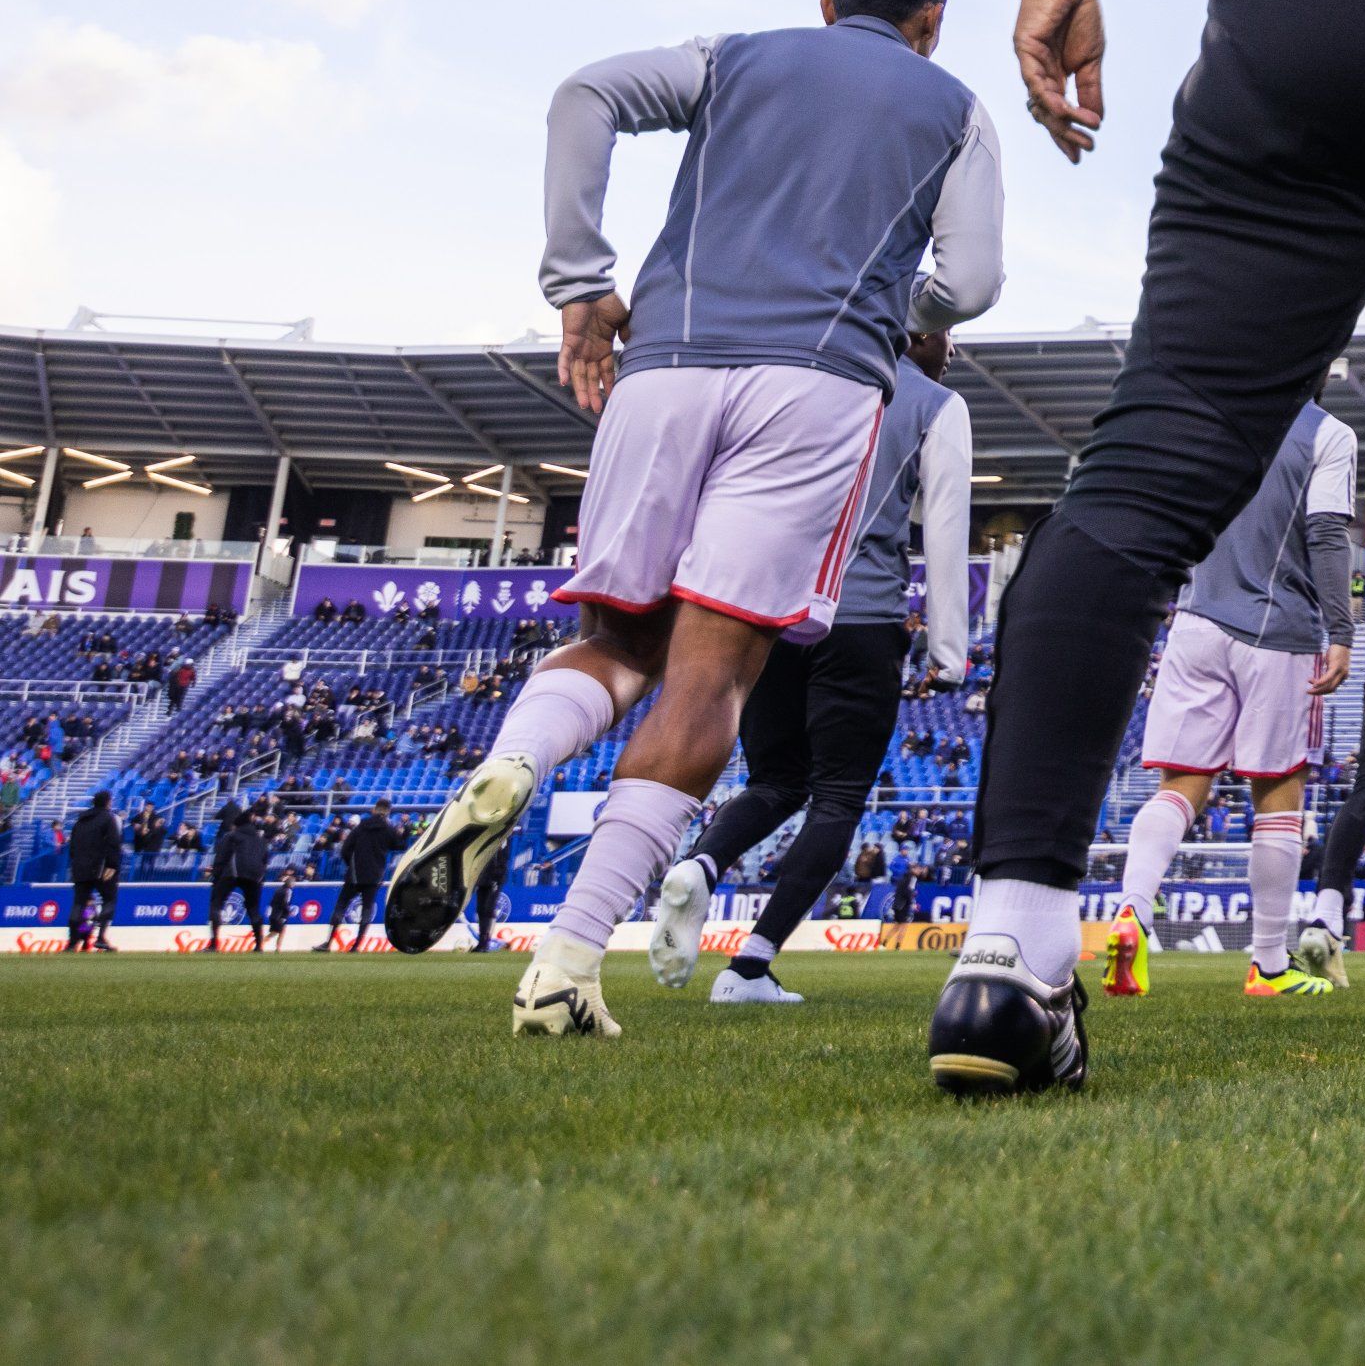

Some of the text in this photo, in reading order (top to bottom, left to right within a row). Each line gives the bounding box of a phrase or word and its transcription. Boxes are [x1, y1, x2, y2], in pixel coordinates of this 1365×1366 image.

[0, 569, 98, 604] AIS
[438, 856, 448, 894] ZOOM
[4, 905, 39, 918] BMO
[134, 904, 169, 917] BMO
[961, 949, 1018, 968] adidas
